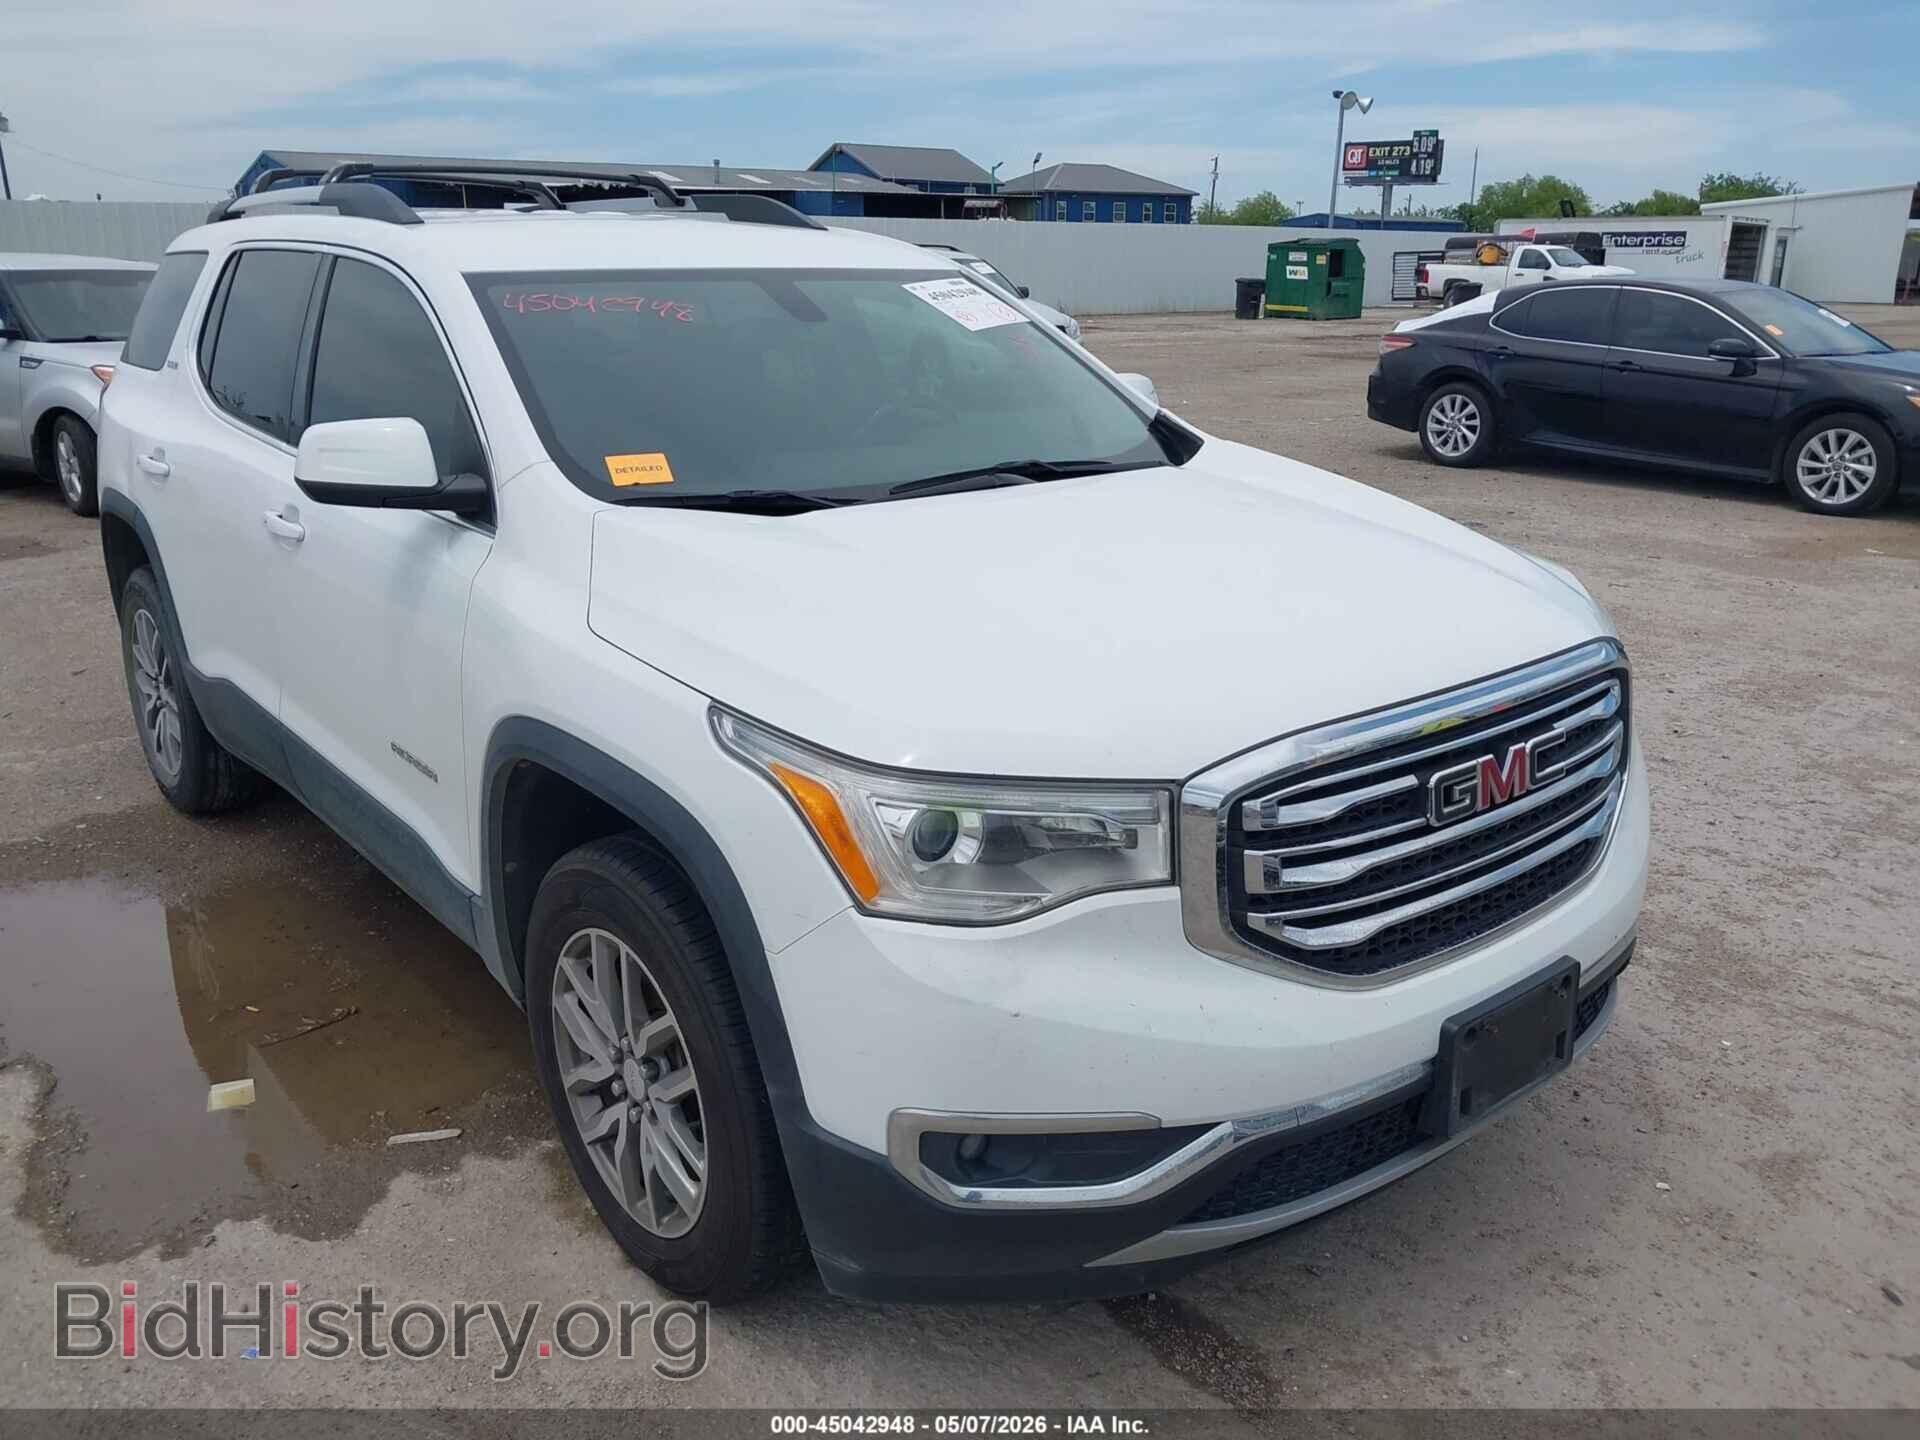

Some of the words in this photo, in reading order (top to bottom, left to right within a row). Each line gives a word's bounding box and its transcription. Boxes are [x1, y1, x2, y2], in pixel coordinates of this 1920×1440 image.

[1348, 148, 1363, 163] QT
[1369, 147, 1390, 157] EXIT
[1392, 146, 1411, 156] 273
[1602, 233, 1684, 247] Enterprise
[1428, 727, 1567, 827] GMC
